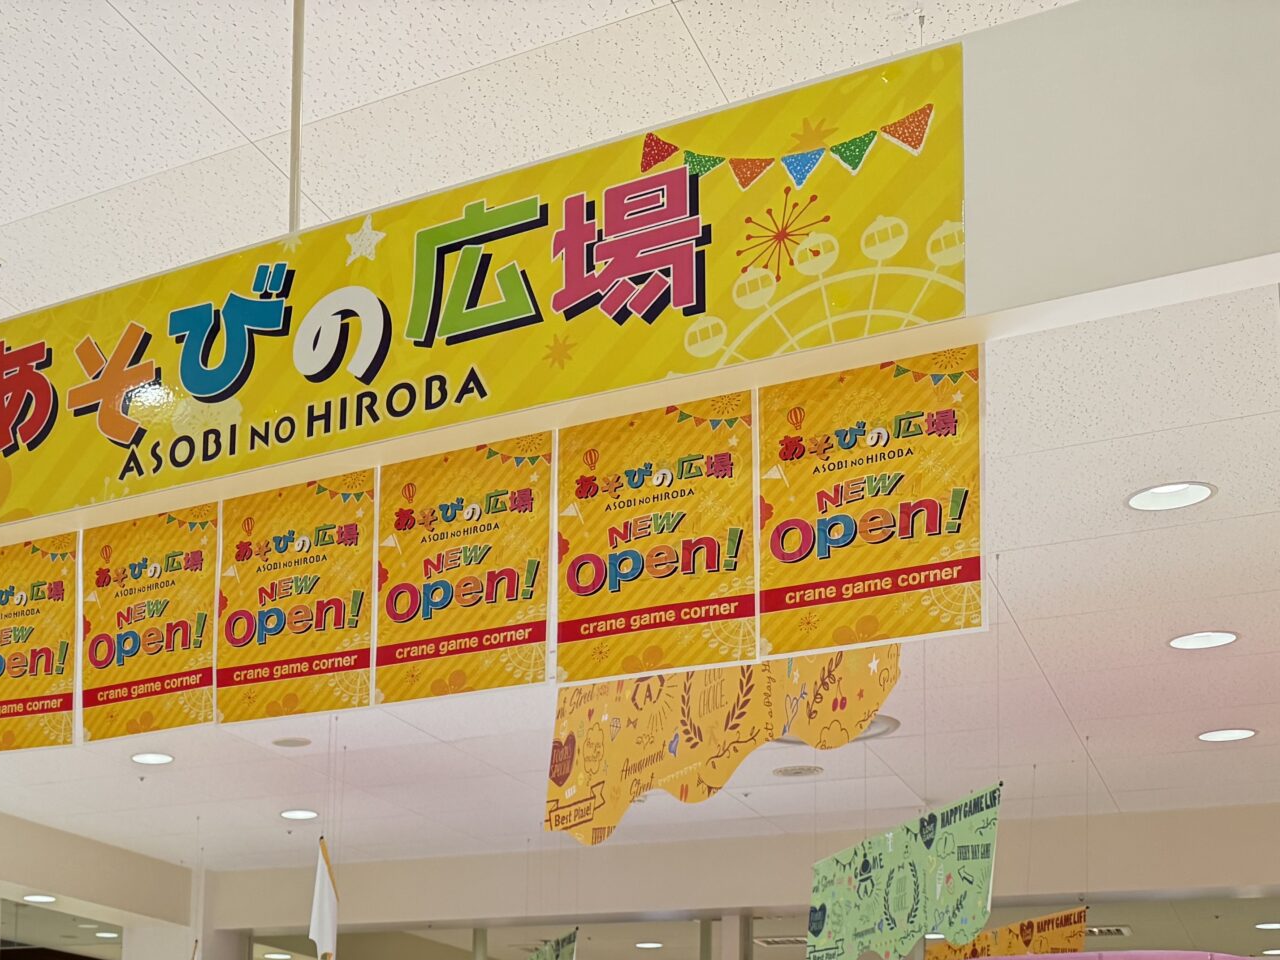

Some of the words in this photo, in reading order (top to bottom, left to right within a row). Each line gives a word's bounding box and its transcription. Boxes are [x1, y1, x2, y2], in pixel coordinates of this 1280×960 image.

[118, 424, 237, 480] ASOBI
[250, 416, 296, 450] NO
[306, 366, 488, 438] HIROBA
[778, 406, 958, 462] あそびの広場
[575, 450, 734, 500] あそびの広場
[812, 459, 847, 475] ASOBI
[851, 457, 863, 467] NO
[866, 446, 914, 464] HIROBA
[395, 487, 534, 532] あそびの広場
[605, 498, 635, 512] ASOBI
[652, 487, 695, 503] HIROBA
[815, 471, 905, 514] NEW
[234, 521, 359, 562] あそびの広場
[420, 531, 448, 544] ASOBI
[462, 521, 499, 536] HIROBA
[607, 510, 687, 549] NEW
[769, 487, 968, 562] Open!
[95, 548, 202, 588] あそびの広場
[422, 542, 492, 579] NEW
[258, 573, 320, 606] NEW
[785, 583, 836, 604] crane
[841, 574, 891, 598] game
[897, 564, 961, 588] corner
[116, 597, 170, 630] NEW
[579, 615, 626, 634] crane
[630, 608, 675, 630] game
[680, 599, 737, 621] corner
[395, 641, 436, 659] crane
[439, 634, 478, 655] game
[482, 626, 531, 646] corner
[554, 812, 572, 828] Best
[941, 804, 963, 829] HAPPY
[963, 794, 984, 819] GAME
[1037, 917, 1054, 933] HAPPY
[1055, 914, 1073, 928] GAME
